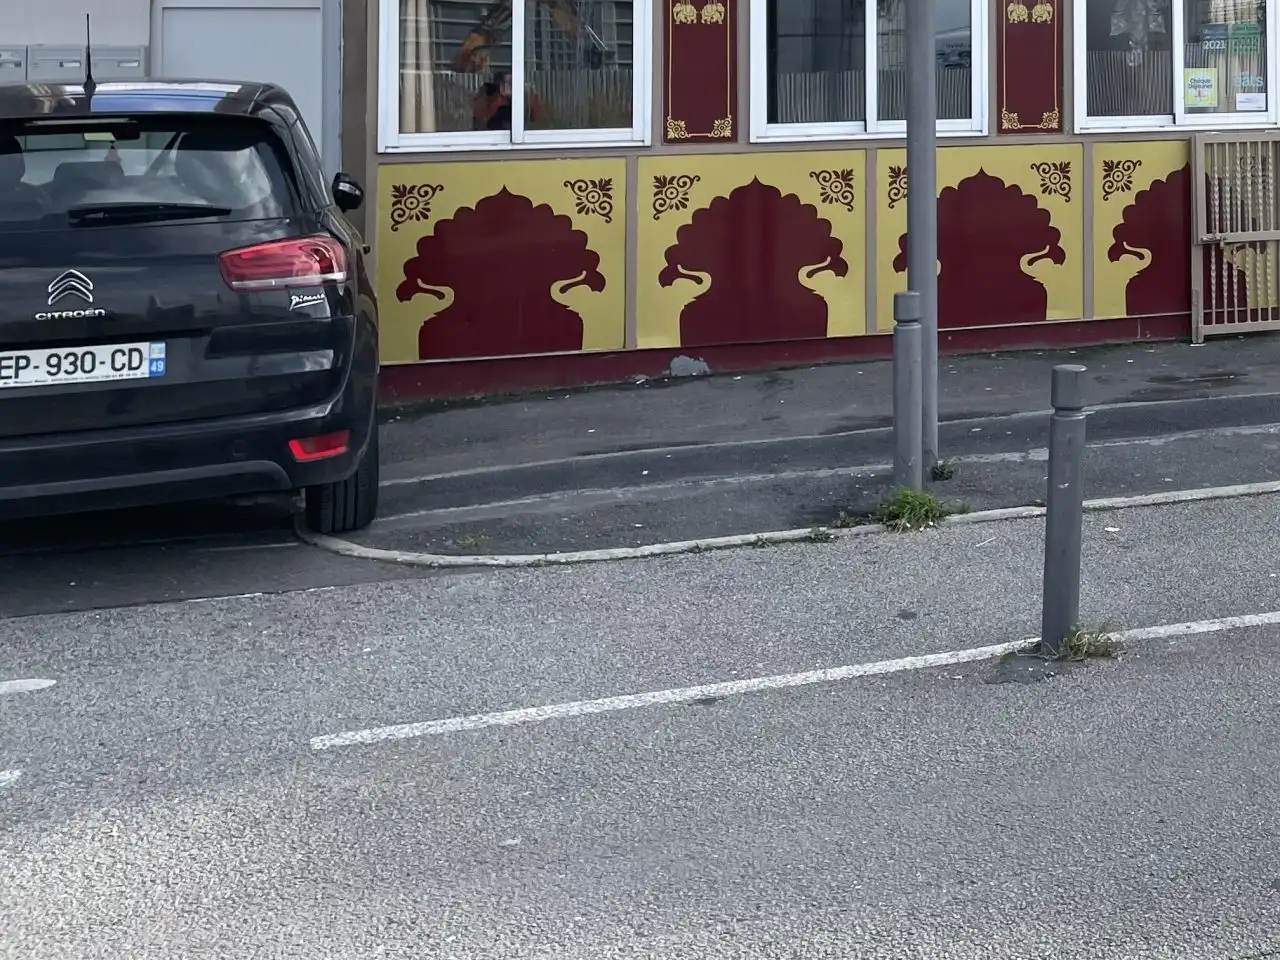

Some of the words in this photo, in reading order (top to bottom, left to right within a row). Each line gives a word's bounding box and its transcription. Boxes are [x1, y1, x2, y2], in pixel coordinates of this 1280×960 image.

[1203, 40, 1226, 50] 2021
[35, 307, 106, 321] CITROËN
[150, 360, 164, 373] 49
